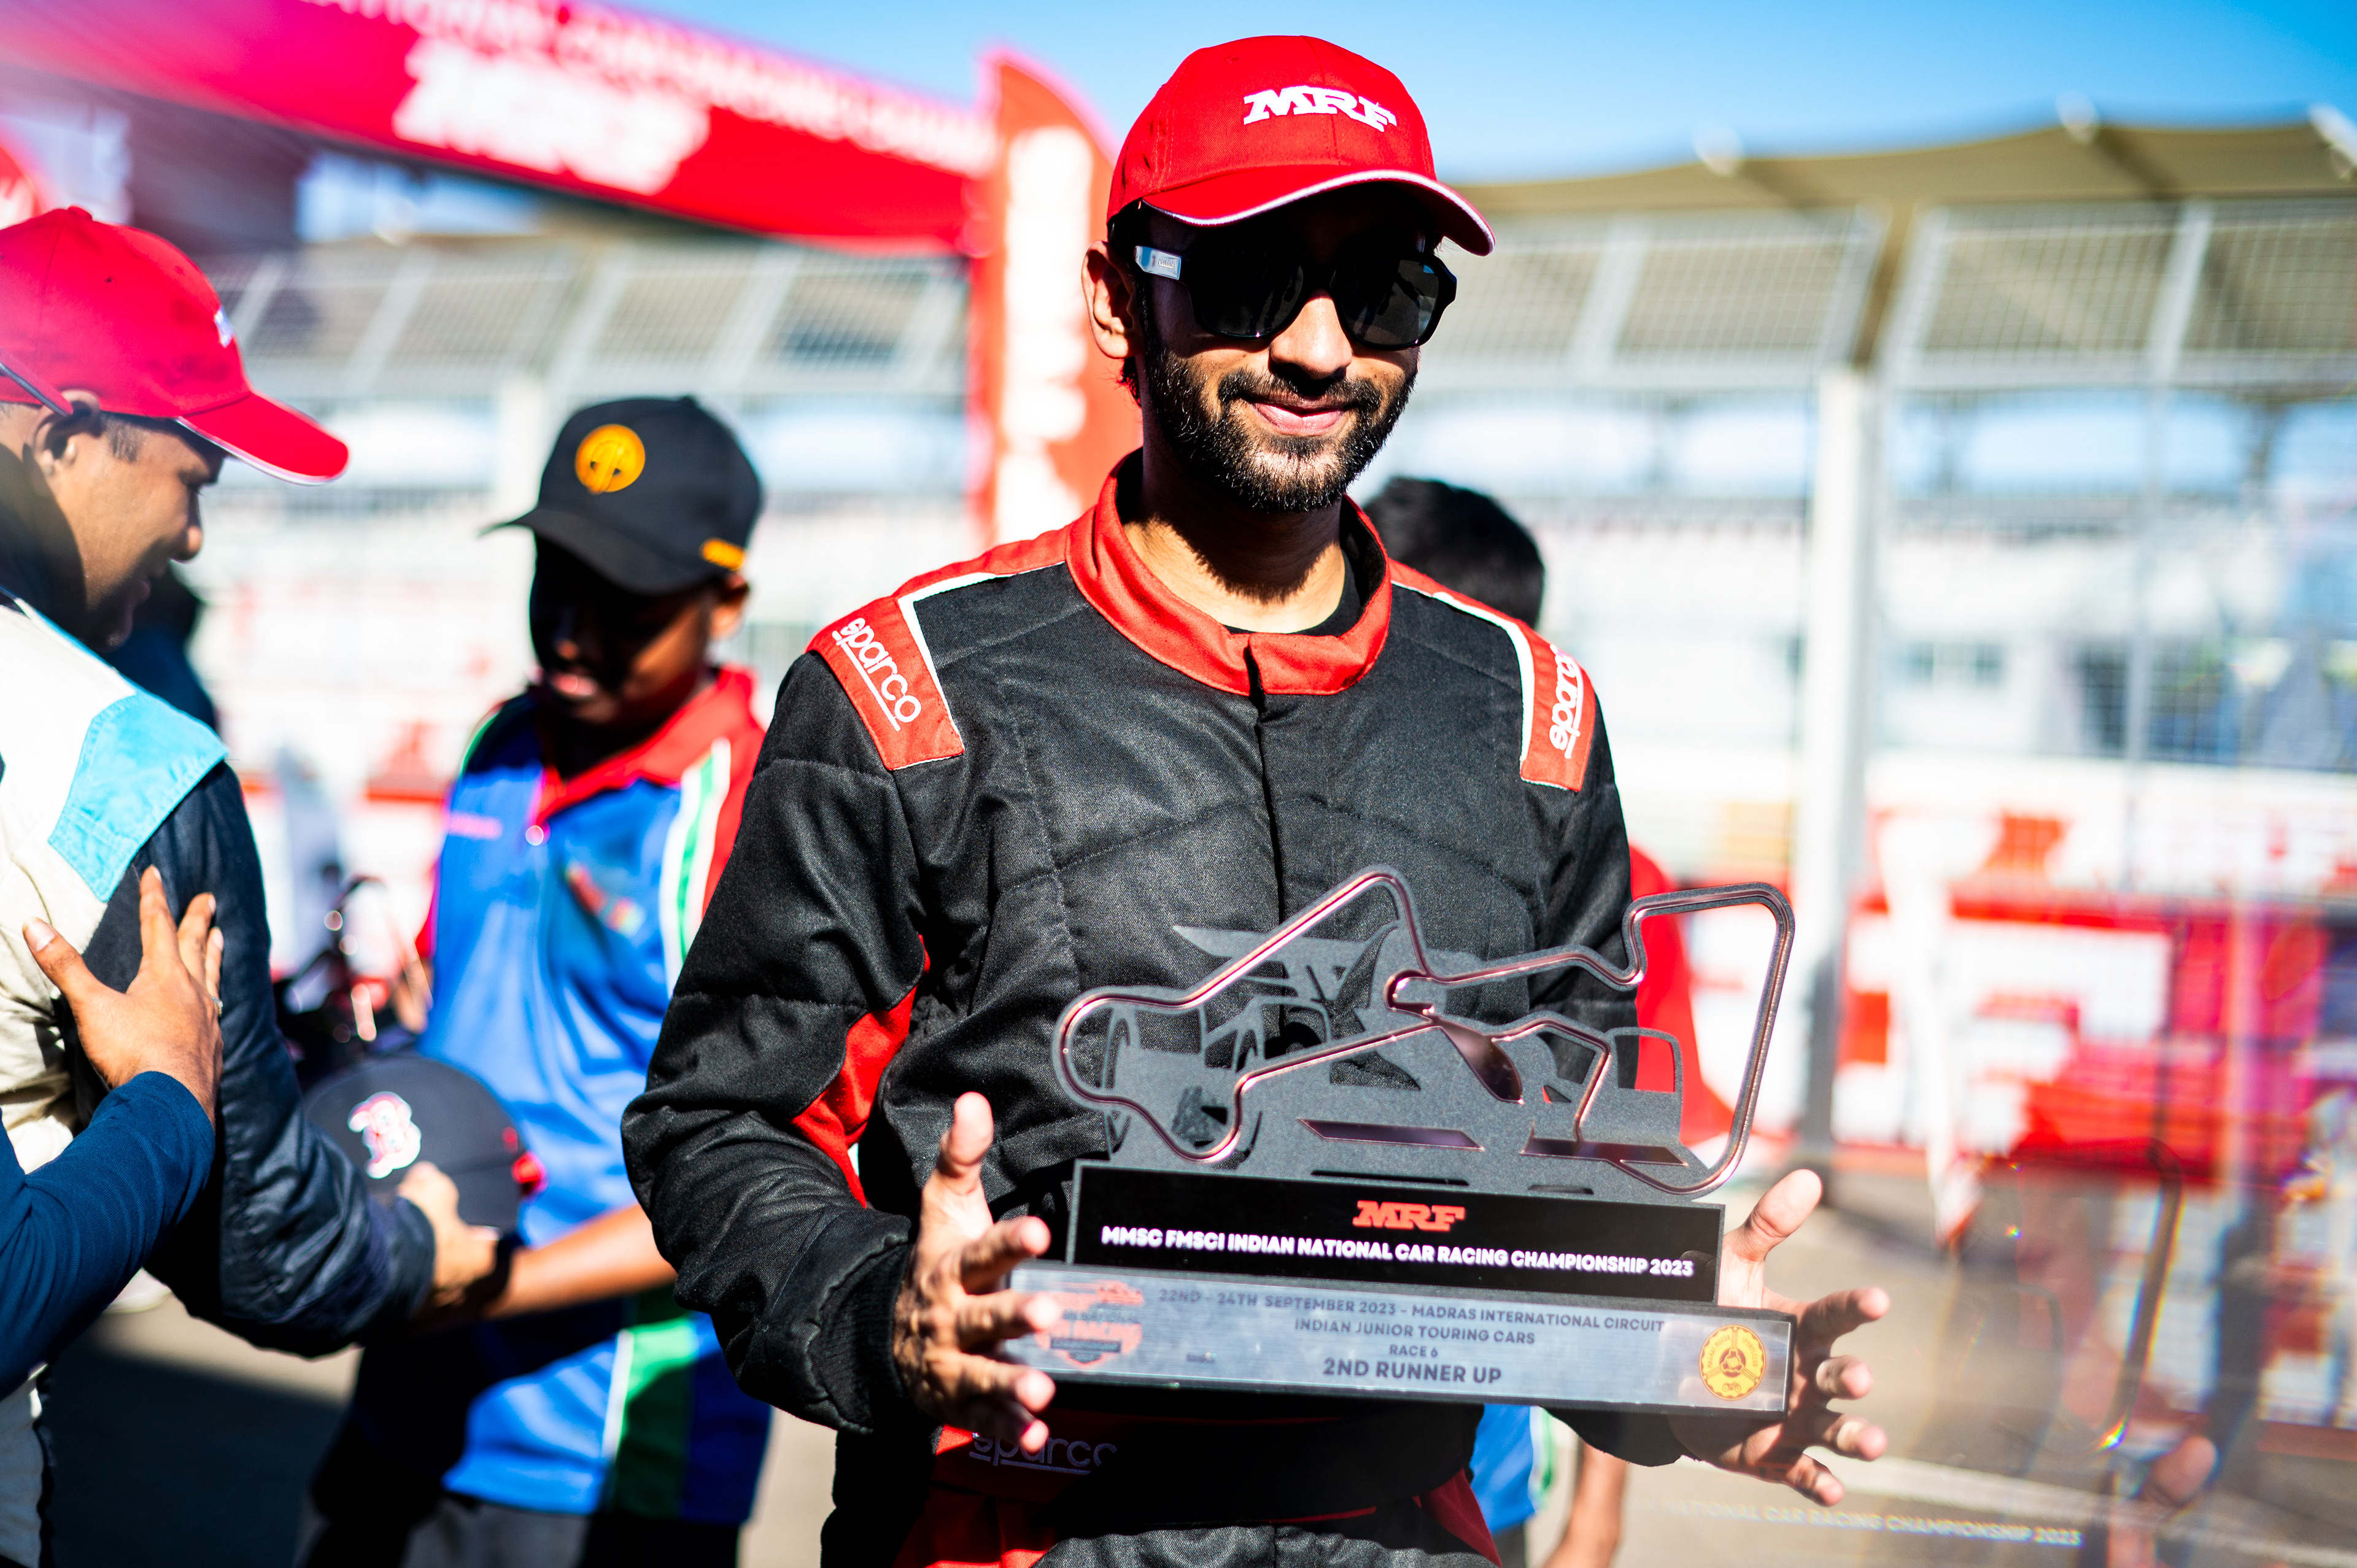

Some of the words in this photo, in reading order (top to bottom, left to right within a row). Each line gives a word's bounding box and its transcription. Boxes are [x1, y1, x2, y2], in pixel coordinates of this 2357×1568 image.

[1243, 85, 1398, 133] MRF
[832, 617, 922, 731] sparco
[1352, 1200, 1466, 1232] MRF
[1101, 1226, 1163, 1248] MMSC
[1165, 1229, 1226, 1251] FMSCI
[1228, 1233, 1295, 1254] INDIAN
[1297, 1237, 1393, 1261] NATIONAL
[1395, 1243, 1434, 1262] CAR
[1437, 1246, 1509, 1267] RACING
[1511, 1250, 1649, 1274] CHAMPIONSHIP
[1649, 1258, 1695, 1278] 2023
[1159, 1288, 1201, 1303] 22ND
[1217, 1291, 1258, 1307] 24TH
[1264, 1294, 1355, 1313] SEPTEMBER
[1358, 1300, 1396, 1315] 2023
[1412, 1305, 1476, 1320] MADRAS
[1480, 1309, 1600, 1328] INTERNATIONAL
[1604, 1317, 1665, 1332] CIRCUIT
[1295, 1318, 1351, 1333] INDIAN
[1355, 1321, 1414, 1337] JUNIOR
[1418, 1325, 1489, 1342] TOURING
[1493, 1330, 1535, 1345] CARS
[1322, 1357, 1369, 1377] 2ND
[1375, 1361, 1466, 1383] RUNNER
[1473, 1366, 1502, 1383] UP
[1389, 1344, 1427, 1358] RACE
[1430, 1346, 1438, 1358] 6
